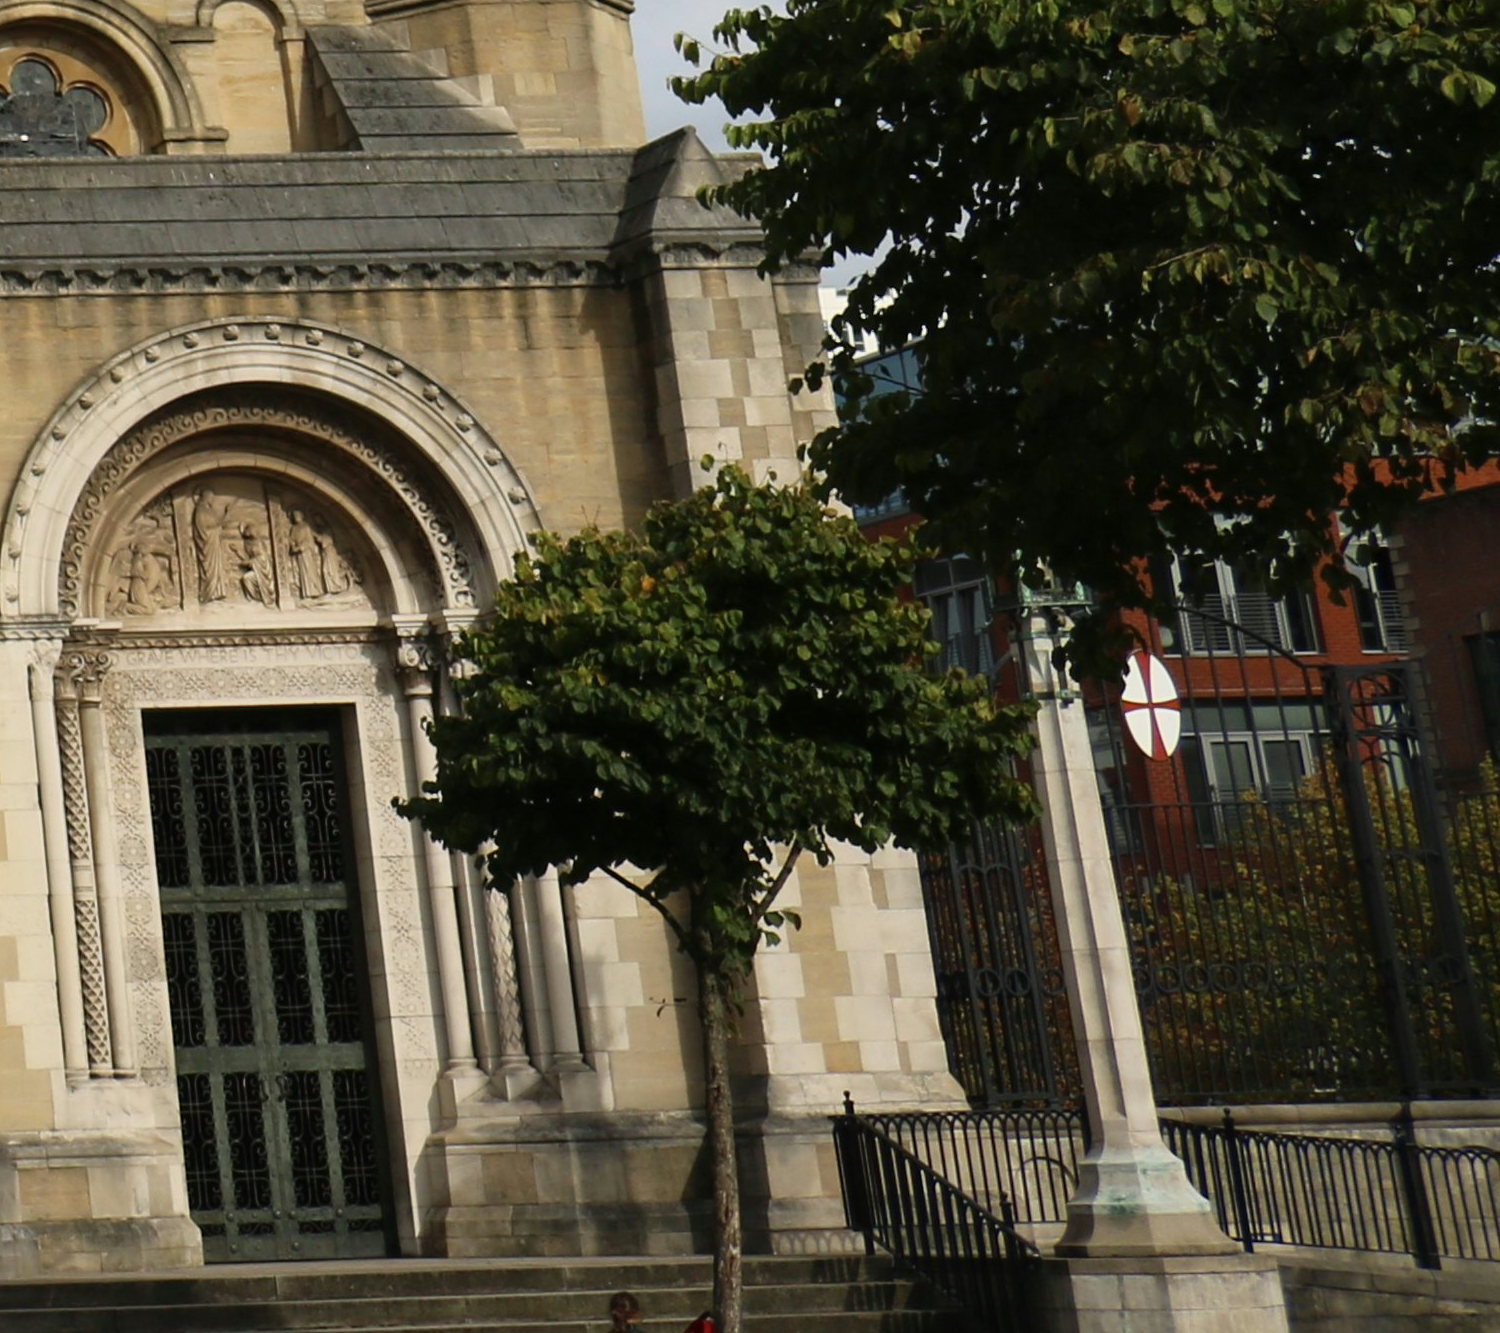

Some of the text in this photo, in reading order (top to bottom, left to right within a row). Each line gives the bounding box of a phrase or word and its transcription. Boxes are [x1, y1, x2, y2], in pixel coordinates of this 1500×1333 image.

[126, 649, 174, 665] GRAVE
[179, 649, 237, 664] WHERE
[244, 648, 257, 662] IS
[266, 647, 299, 662] THY
